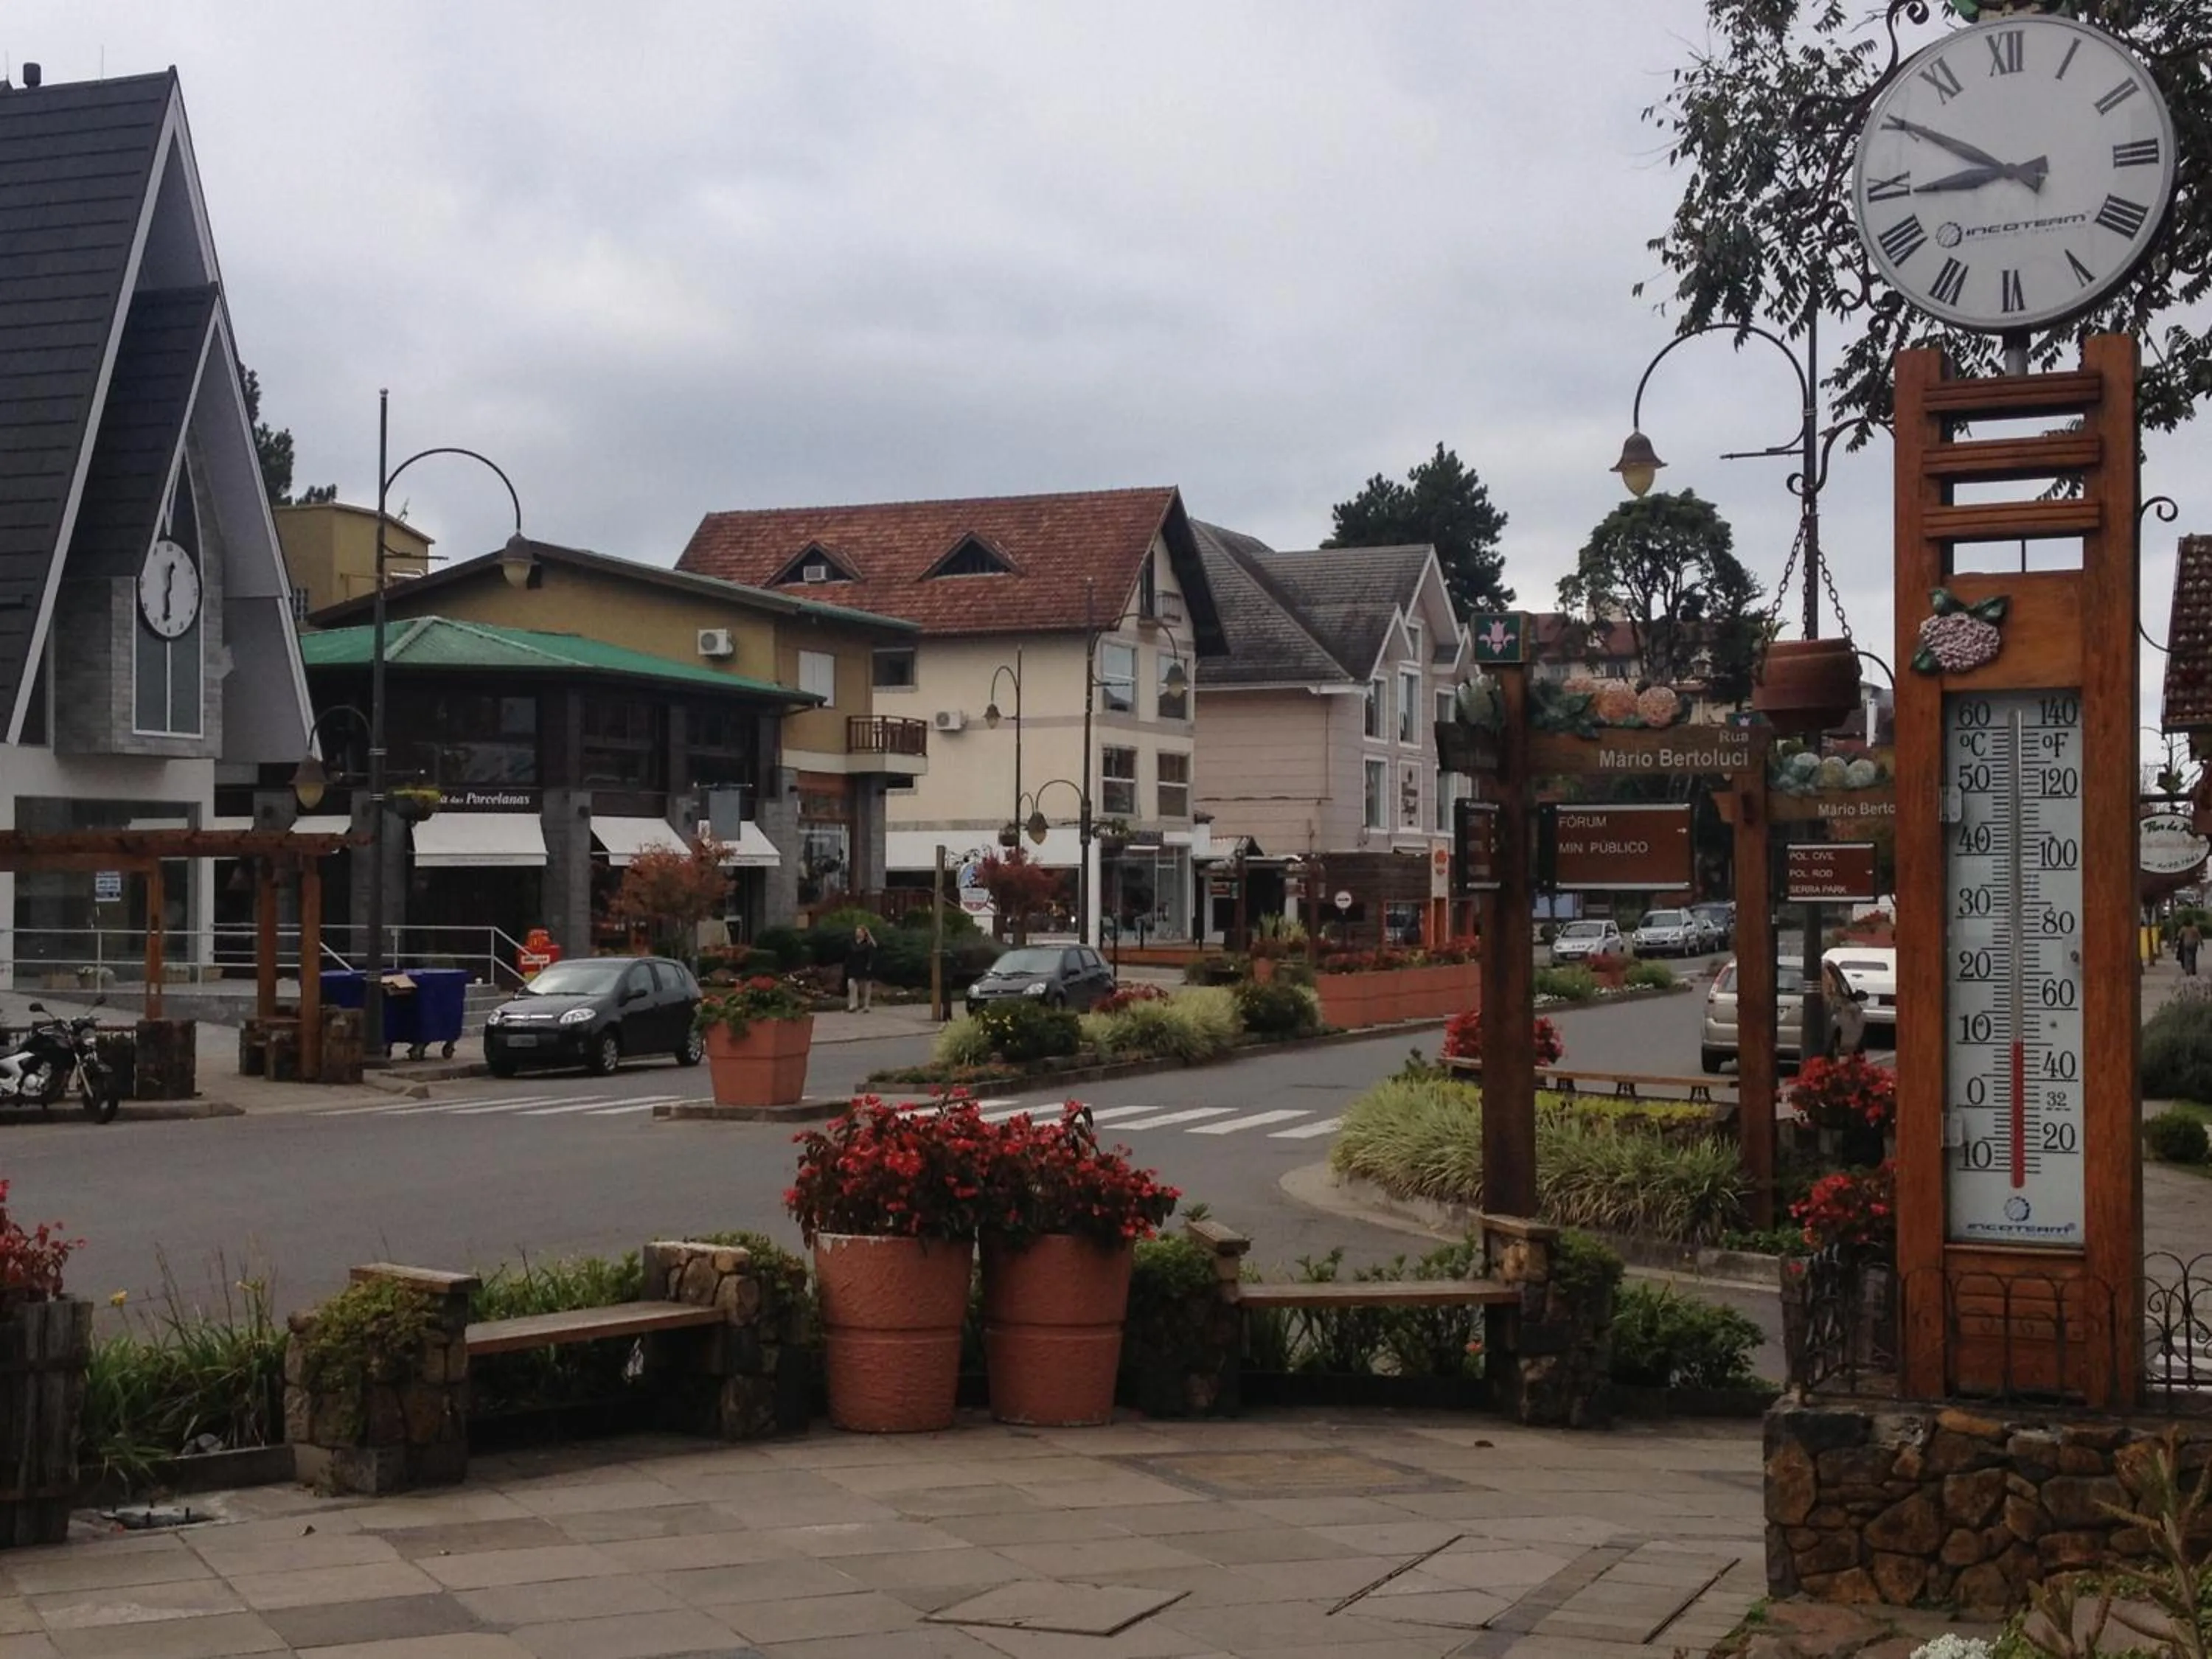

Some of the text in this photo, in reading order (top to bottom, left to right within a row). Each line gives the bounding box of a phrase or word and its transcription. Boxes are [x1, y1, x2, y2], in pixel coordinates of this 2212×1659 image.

[1986, 30, 2024, 77] XII
[1919, 56, 1964, 105] XI
[2094, 77, 2140, 116] II
[2112, 138, 2160, 169] III
[1867, 170, 1911, 203] IX
[1877, 213, 1928, 268] VIII
[1928, 257, 1969, 307] VII
[2064, 248, 2096, 288] V
[2001, 268, 2026, 313] VI
[1958, 701, 1991, 727] 60
[2039, 697, 2077, 726] 140
[1719, 730, 1749, 744] Rua
[1659, 748, 1749, 768] Bertoluci
[1958, 764, 1990, 791] 50
[2039, 768, 2077, 796] 120
[466, 792, 530, 804] Porcelanas
[1958, 825, 1991, 852] 40
[2039, 838, 2077, 868] 100
[1958, 888, 1991, 915] 30
[2042, 910, 2075, 934] 80
[1959, 950, 1991, 978] 20
[2042, 978, 2075, 1007] 60
[1959, 1014, 1991, 1042] 10
[2042, 1051, 2076, 1079] 40
[1966, 1077, 1985, 1105] 0
[2047, 1091, 2067, 1107] 32
[2042, 1123, 2076, 1151] 20
[1961, 1139, 1992, 1168] 10
